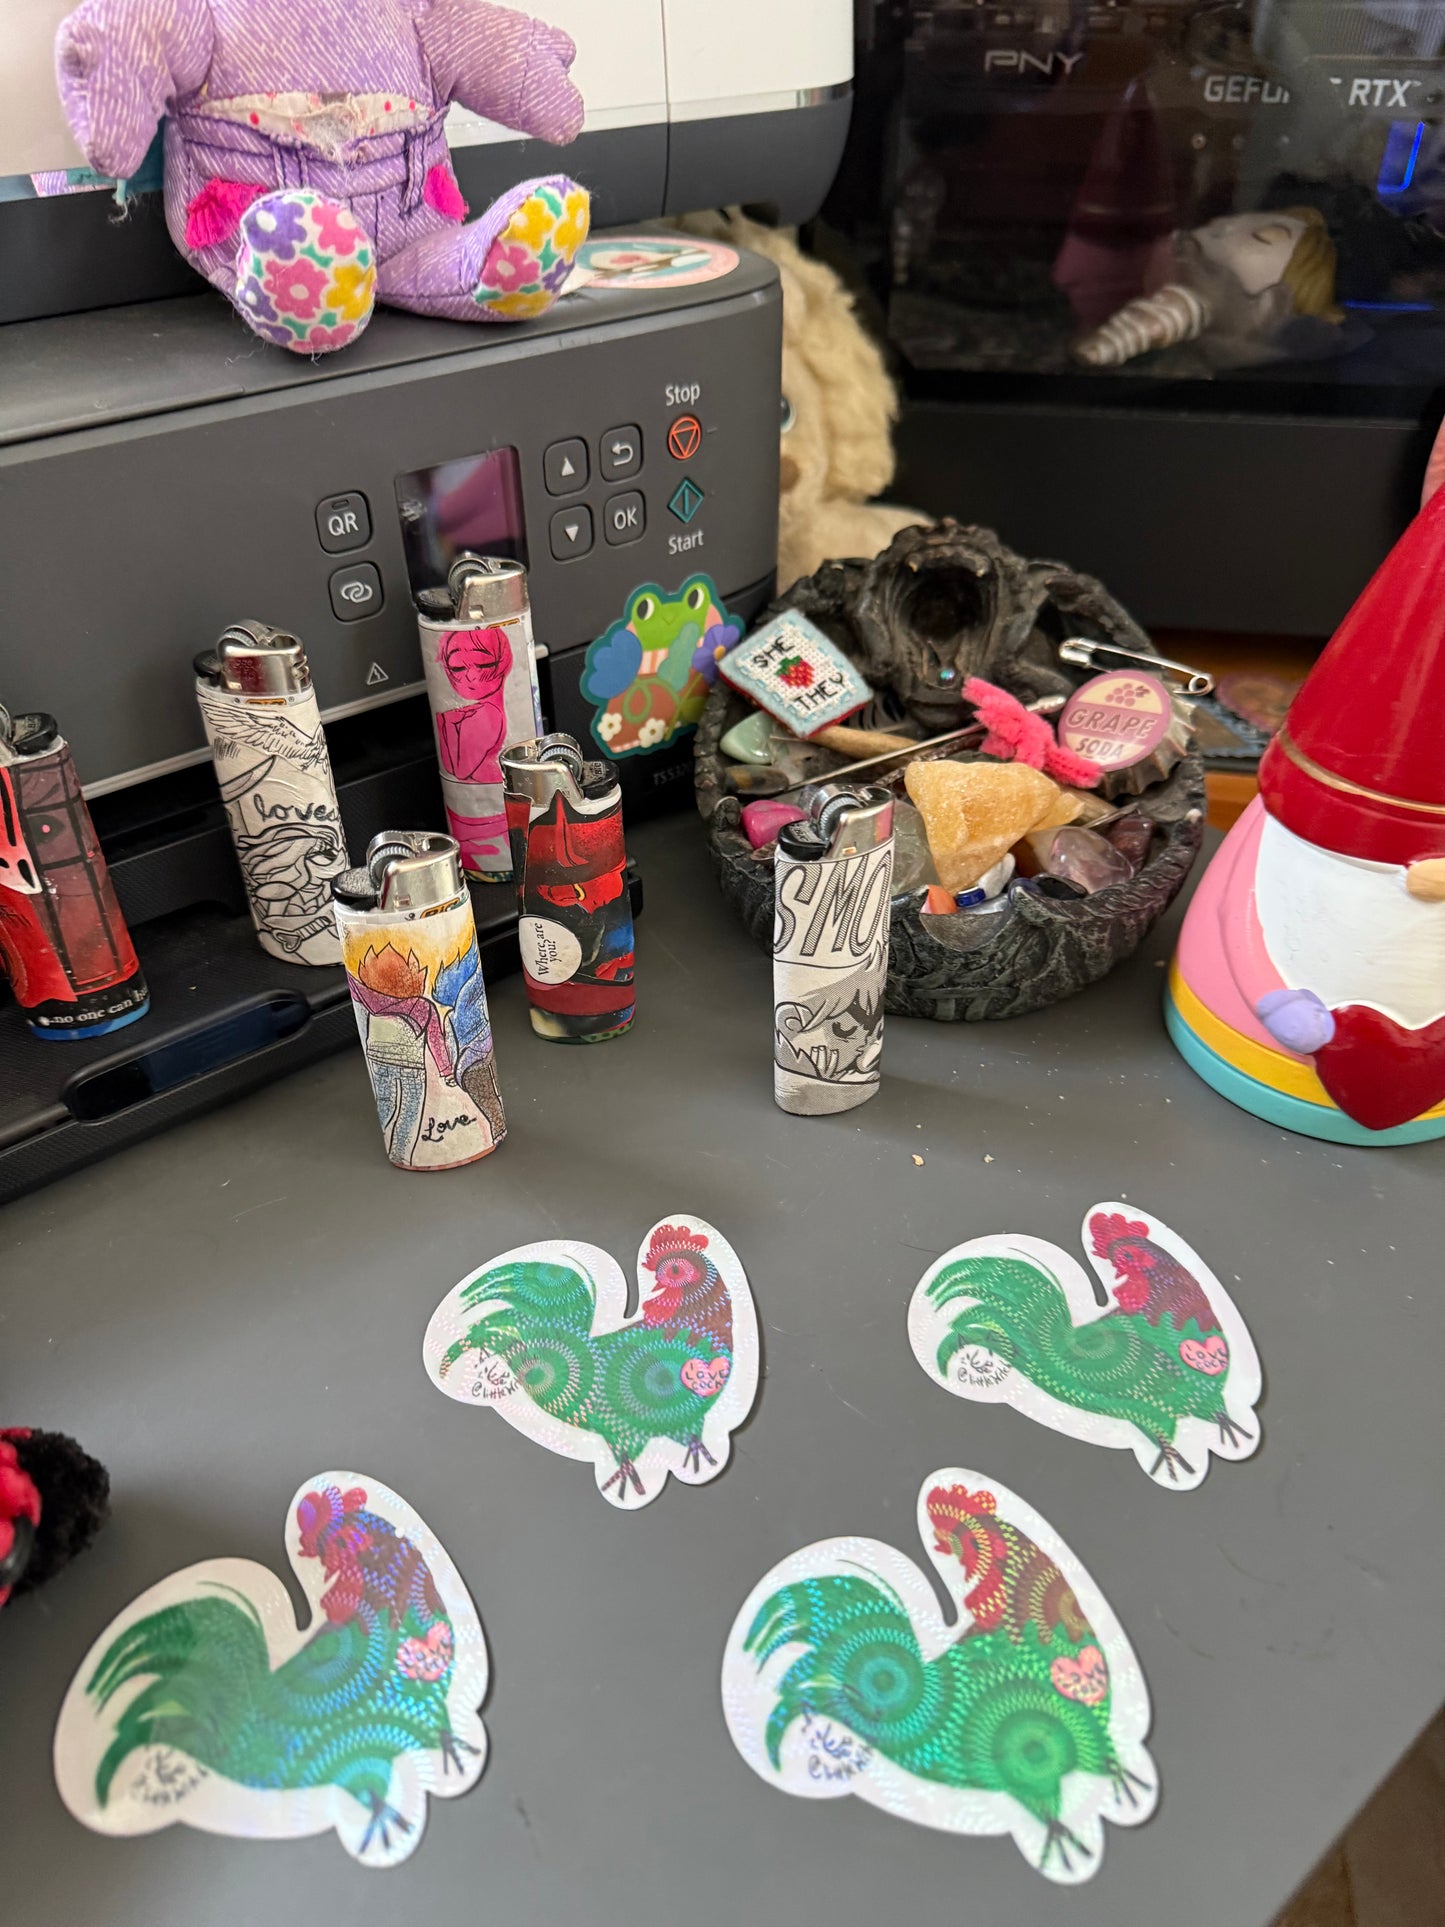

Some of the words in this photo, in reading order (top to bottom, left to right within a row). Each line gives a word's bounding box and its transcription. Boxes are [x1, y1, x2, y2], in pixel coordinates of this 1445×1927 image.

[984, 50, 1083, 74] PNY
[665, 383, 700, 406] Stop
[328, 511, 359, 536] QR
[614, 507, 637, 530] OK
[668, 530, 704, 555] Start
[753, 636, 795, 668] SHE
[793, 673, 846, 711] THEY
[1067, 708, 1156, 738] GRAPE
[1075, 738, 1124, 757] SODA
[107, 999, 133, 1014] can
[421, 1114, 477, 1142] Love
